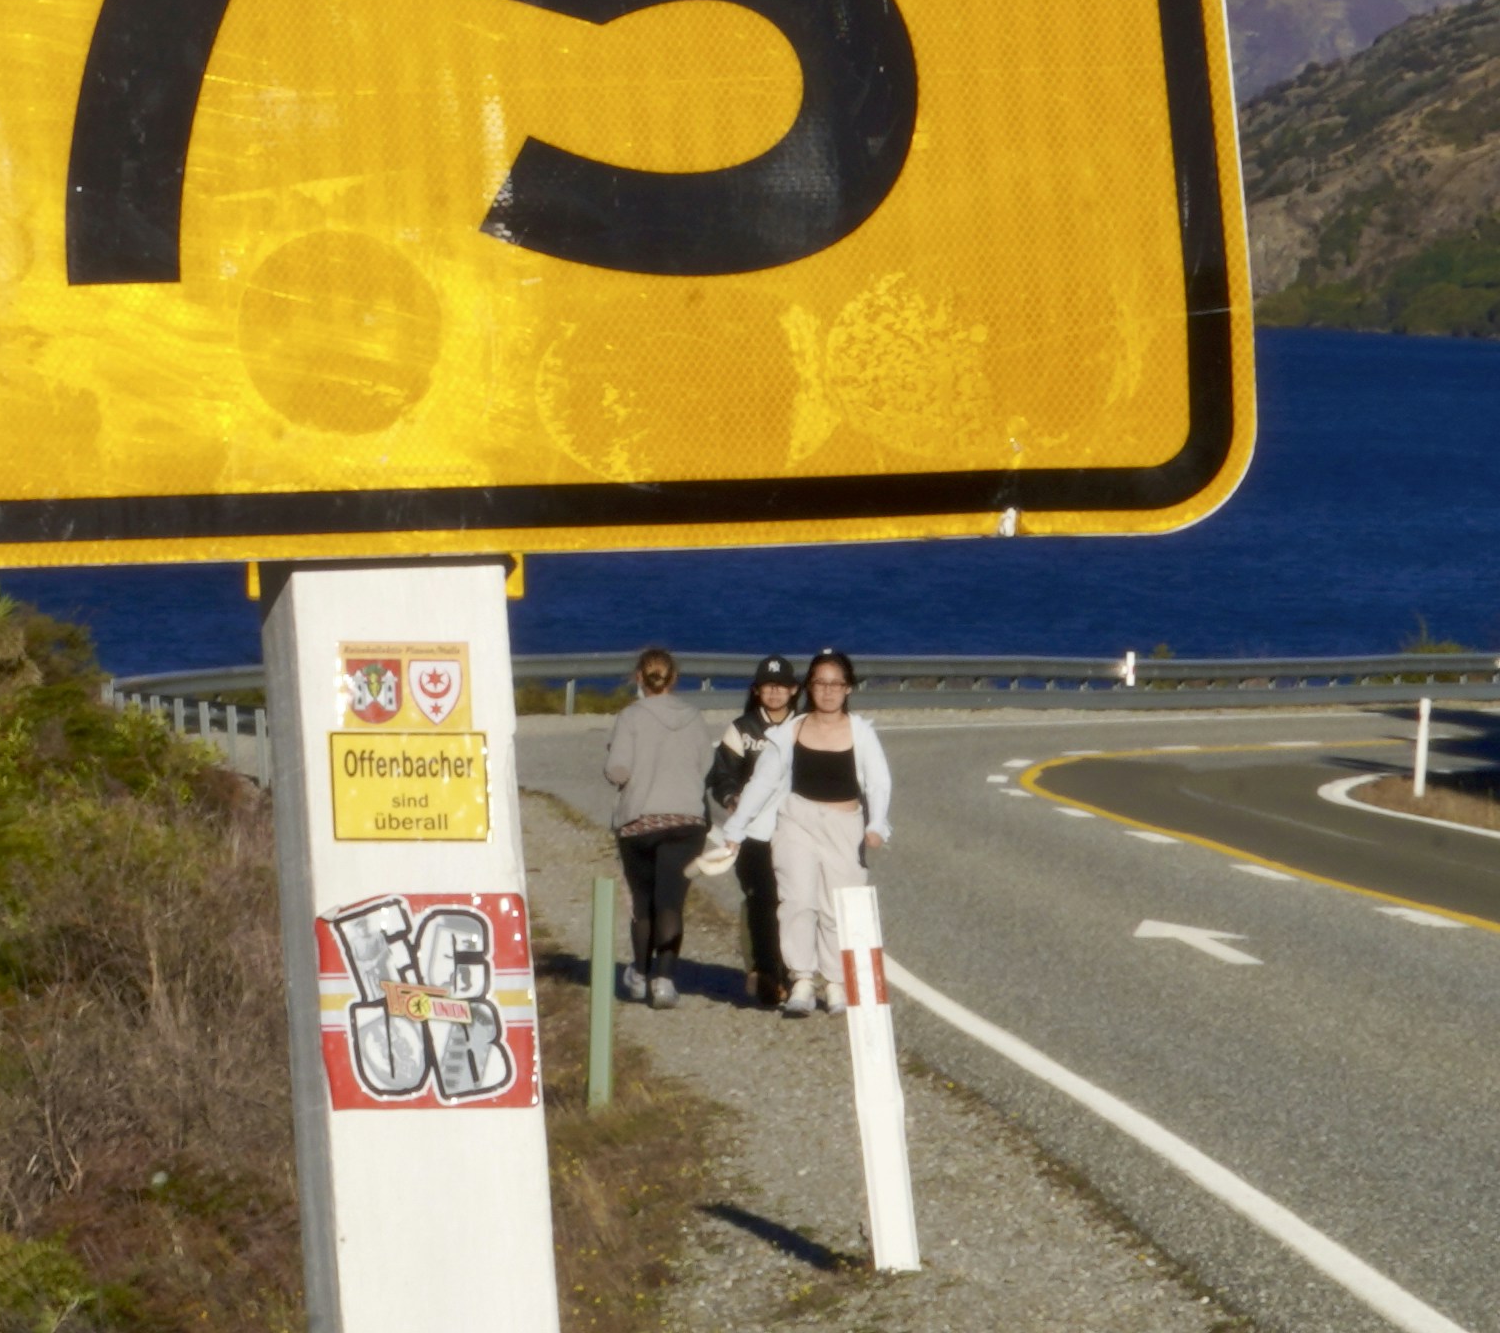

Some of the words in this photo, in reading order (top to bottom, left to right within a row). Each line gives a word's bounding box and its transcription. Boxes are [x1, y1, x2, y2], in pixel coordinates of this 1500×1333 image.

[344, 749, 474, 779] Offenbacher
[392, 793, 429, 808] sind
[374, 812, 449, 831] überall
